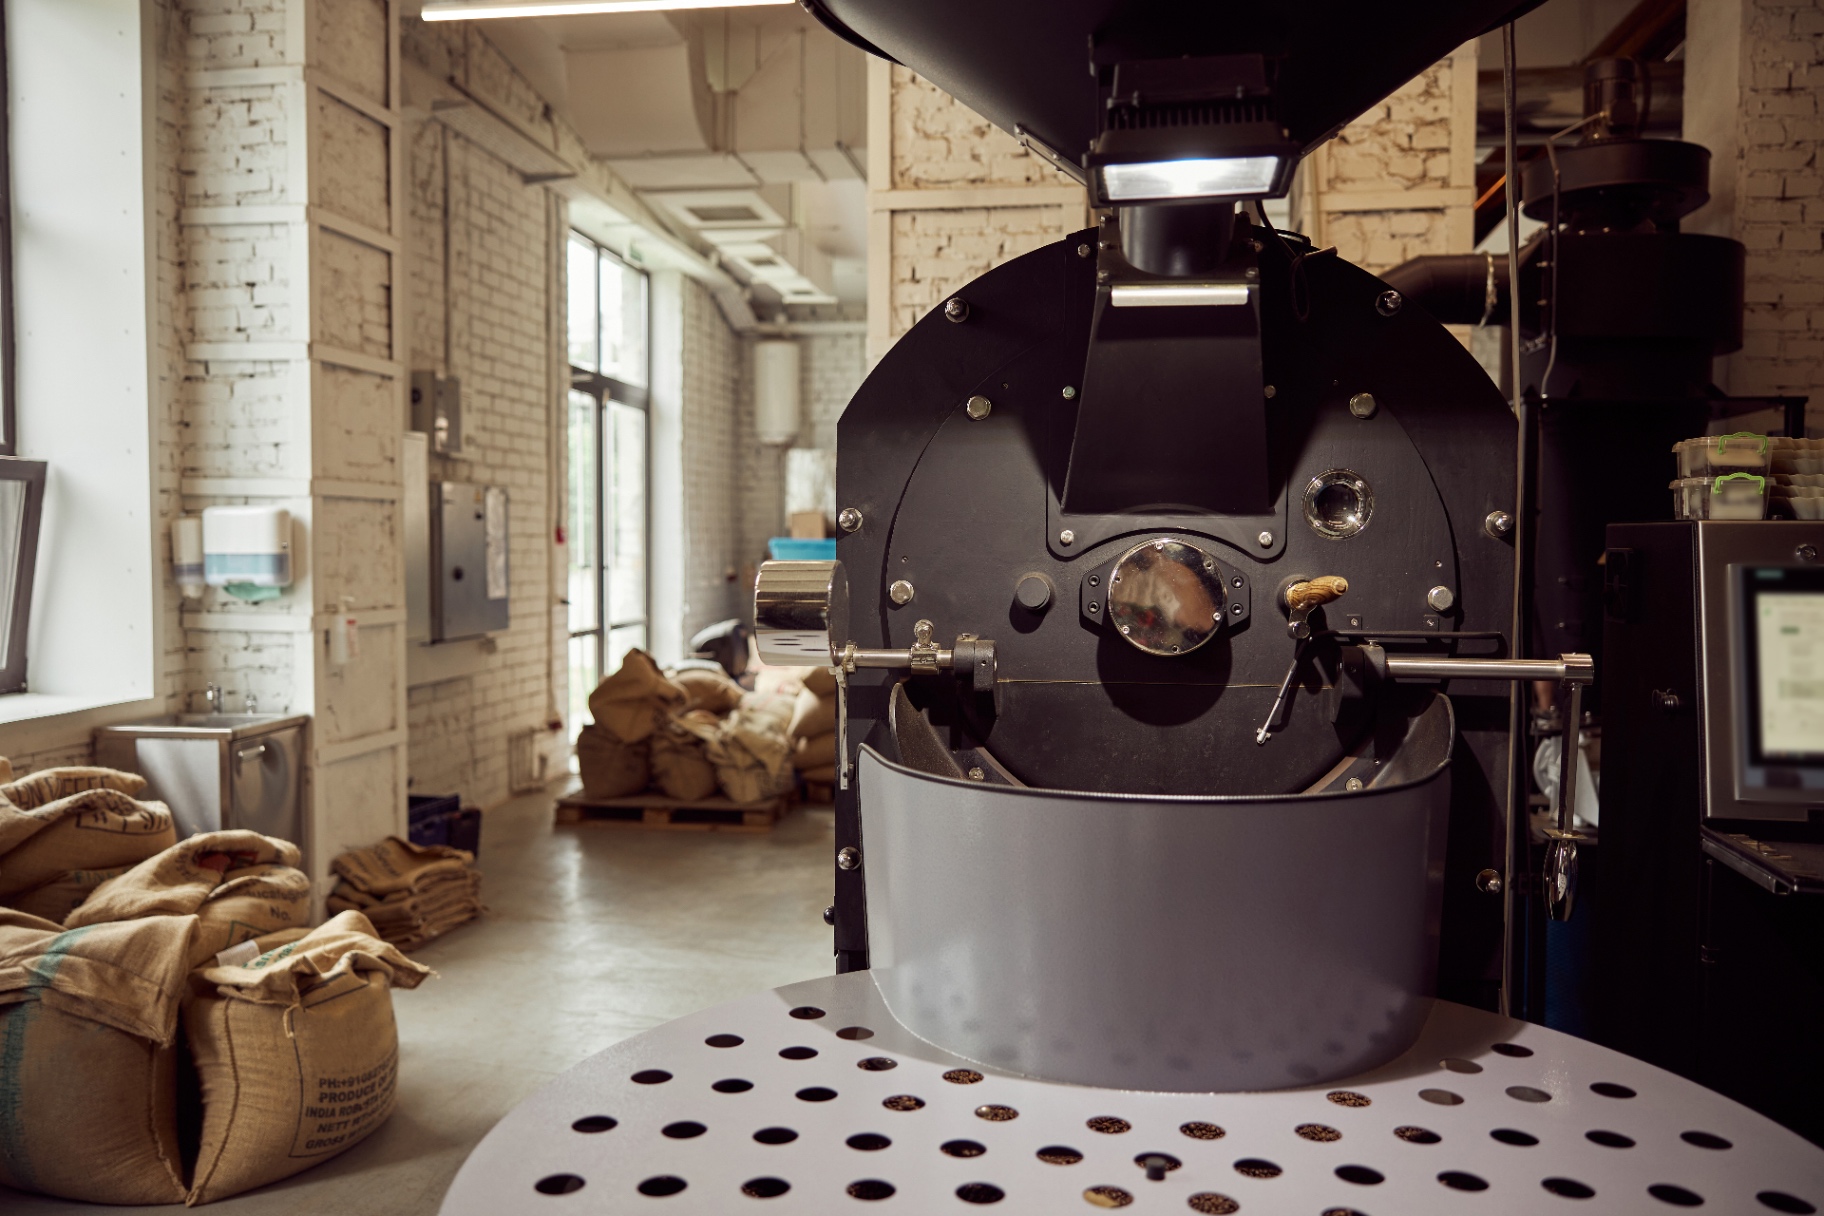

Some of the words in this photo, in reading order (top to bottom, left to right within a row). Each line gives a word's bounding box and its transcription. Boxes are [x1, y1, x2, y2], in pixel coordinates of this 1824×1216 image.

[319, 1082, 376, 1103] PRODUCE
[305, 1106, 336, 1118] INDIA
[317, 1120, 349, 1133] NETT
